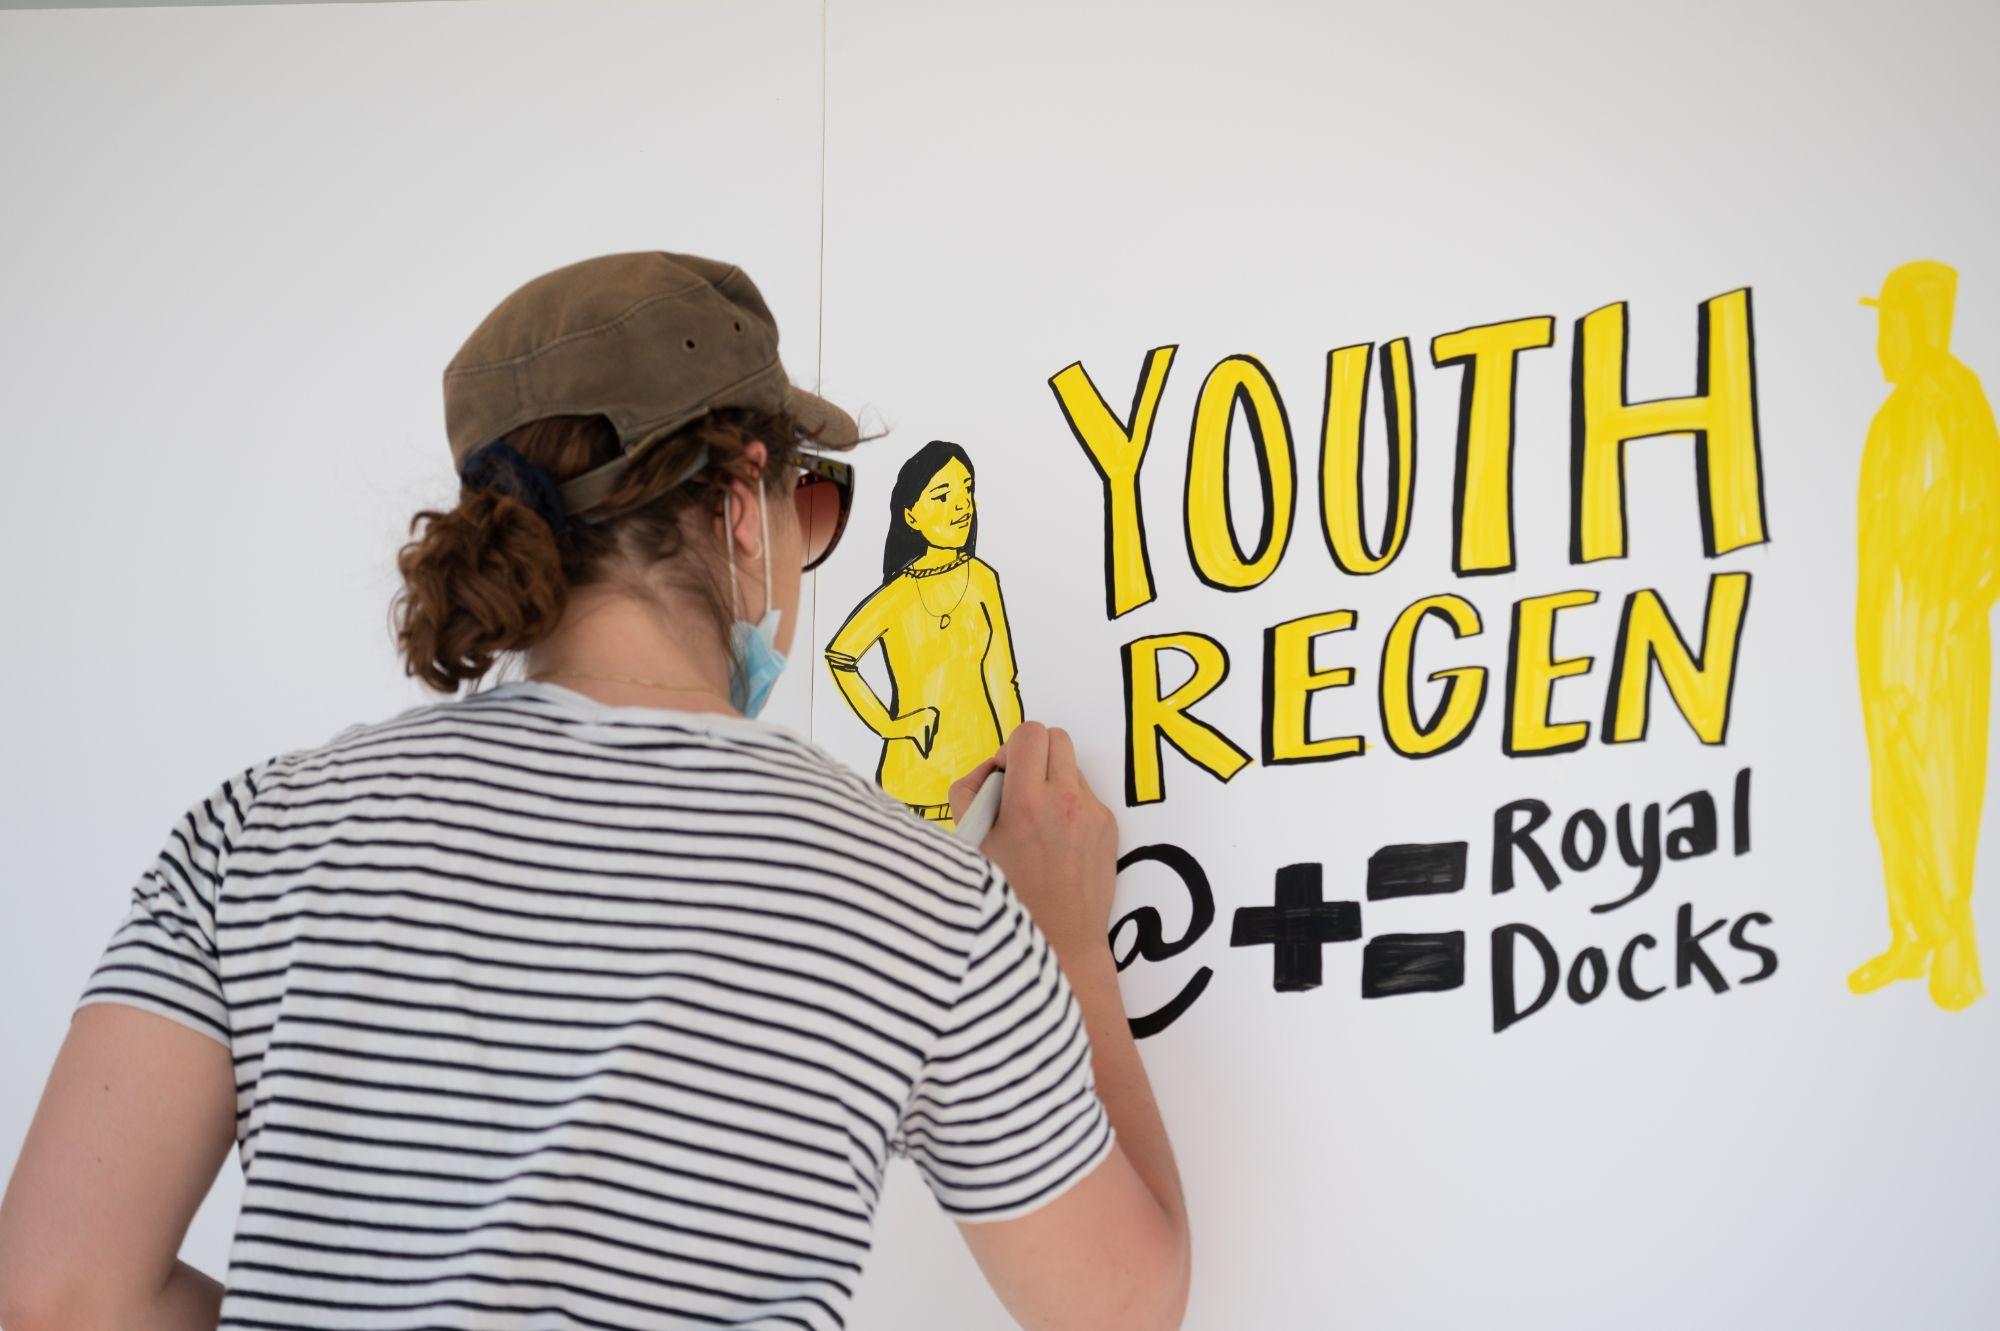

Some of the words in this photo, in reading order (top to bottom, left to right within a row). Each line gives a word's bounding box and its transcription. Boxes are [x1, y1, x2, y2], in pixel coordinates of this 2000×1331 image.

[1047, 286, 1771, 621] YOUTH
[1120, 571, 1753, 808] REGEN
[1491, 767, 1751, 914] Royal
[1491, 902, 1779, 1033] Docks
